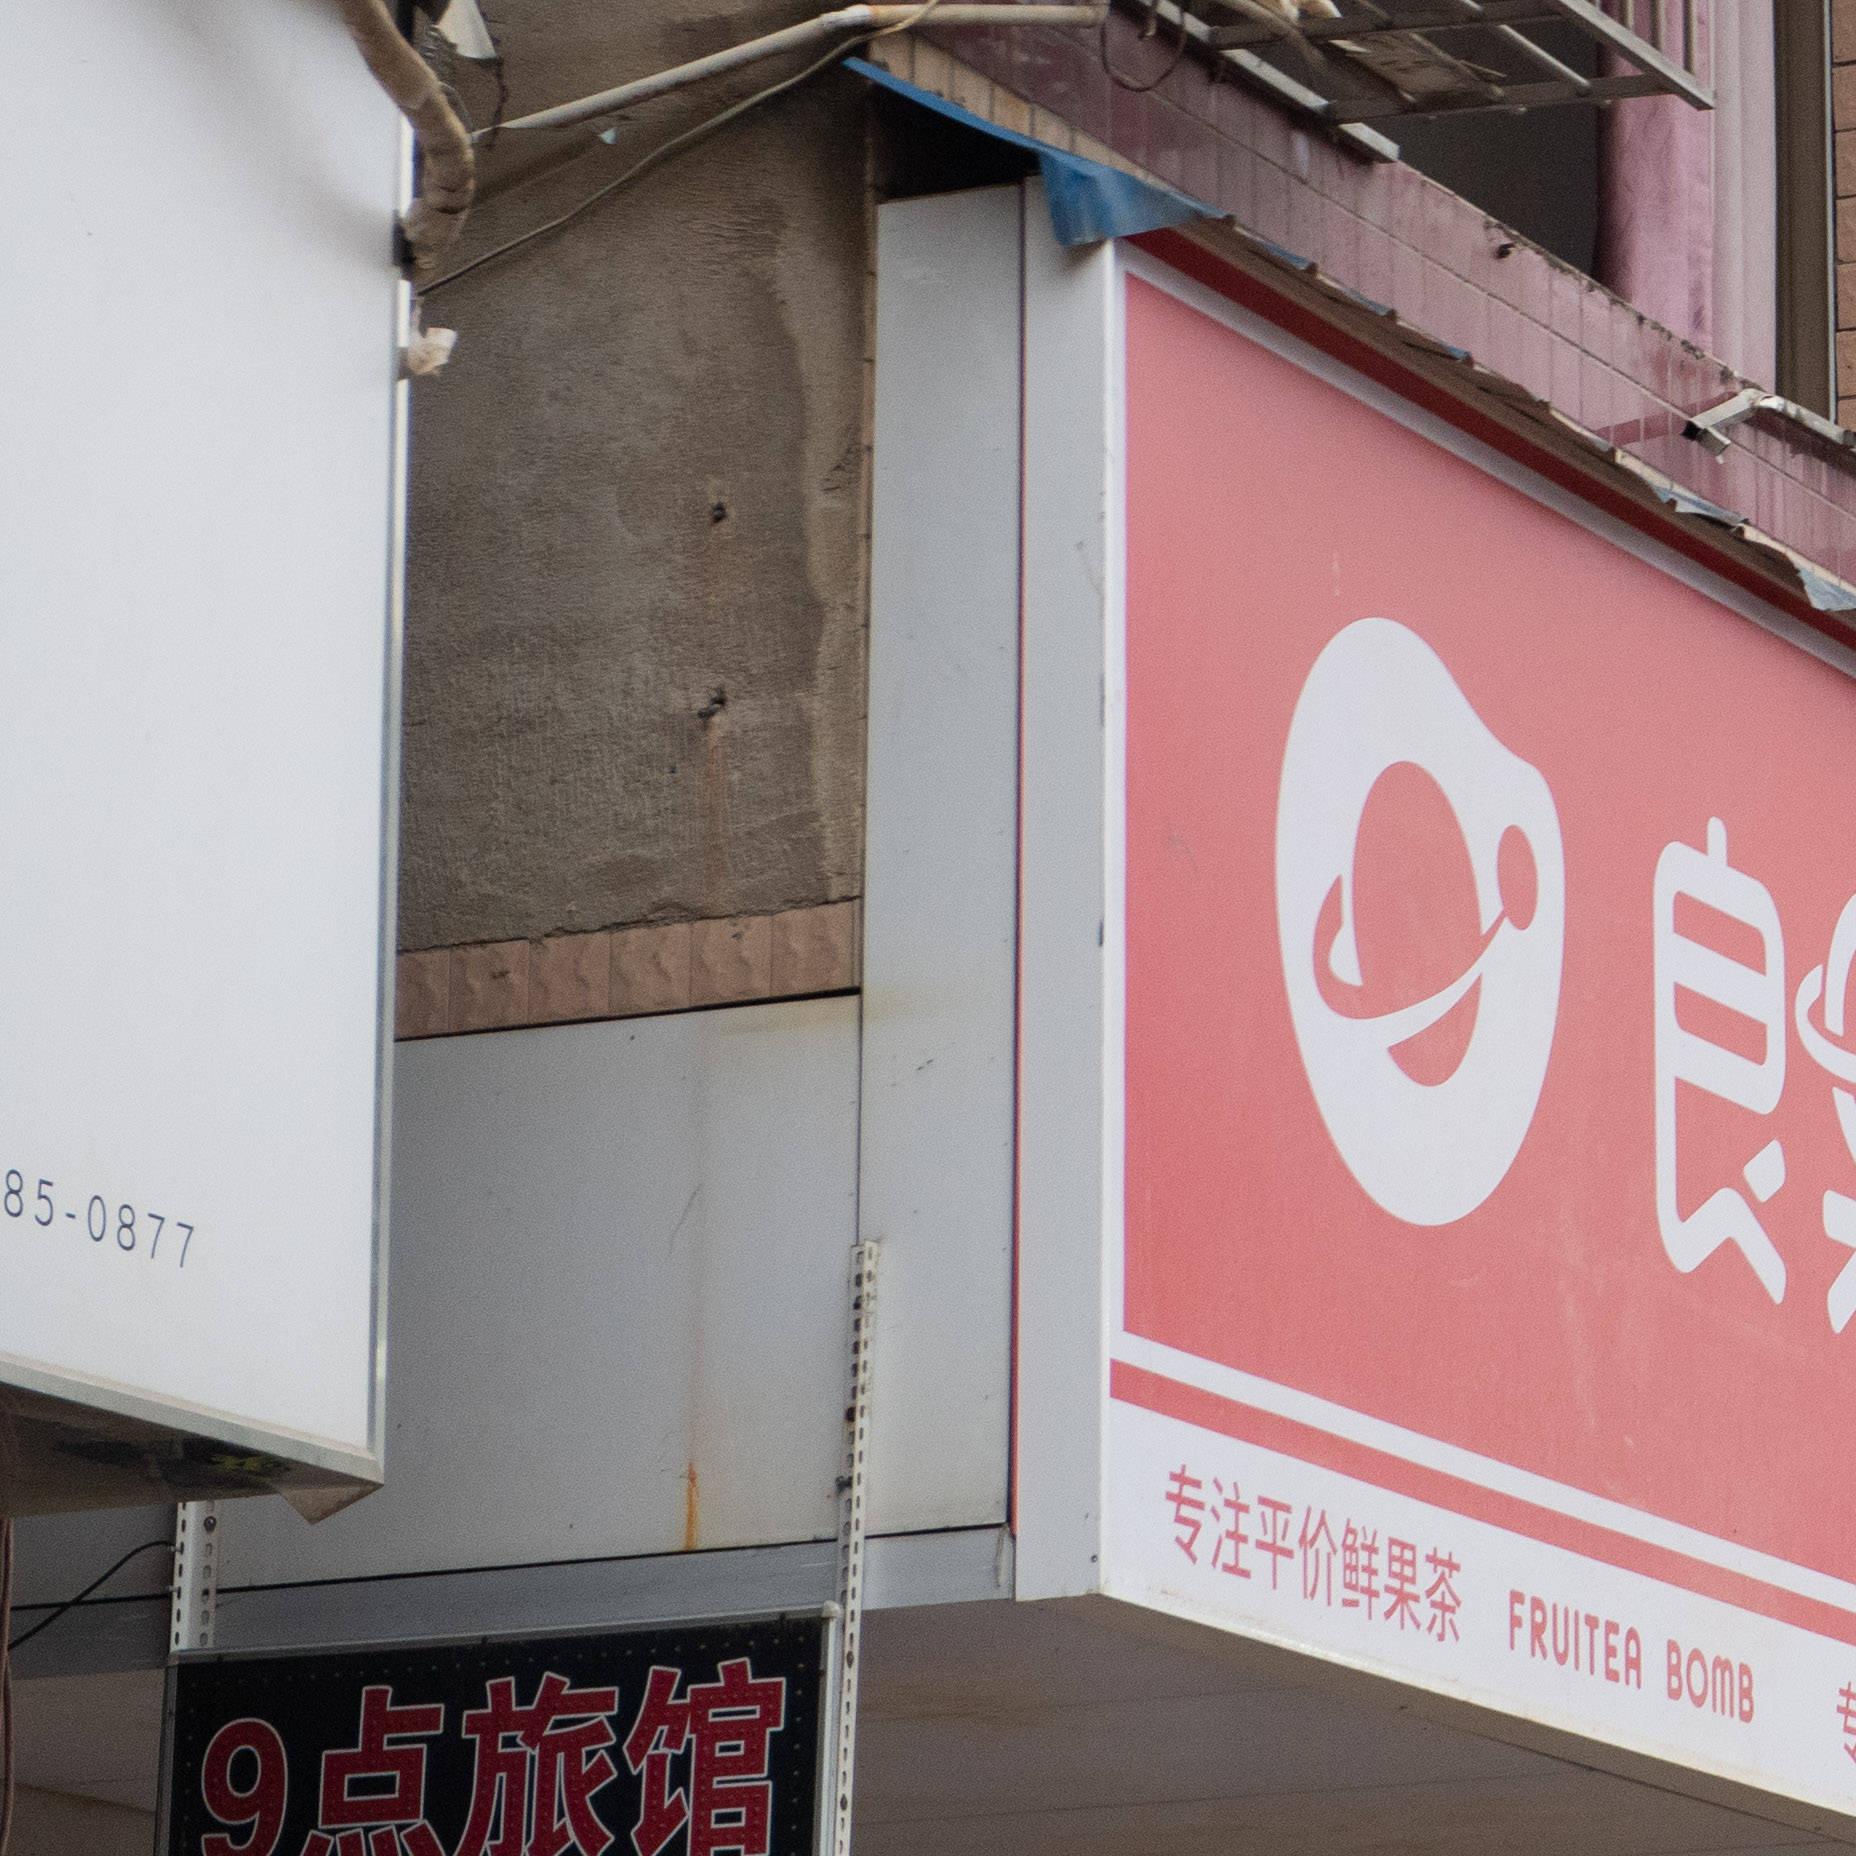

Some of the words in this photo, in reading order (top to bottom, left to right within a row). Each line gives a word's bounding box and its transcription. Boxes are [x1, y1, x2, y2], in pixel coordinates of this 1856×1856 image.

[1165, 1464, 1463, 1643] 专注平价鲜果茶
[1509, 1588, 1642, 1690] FRUITEA
[1666, 1638, 1755, 1724] BOMB
[199, 1657, 787, 1856] 9点旅馆
